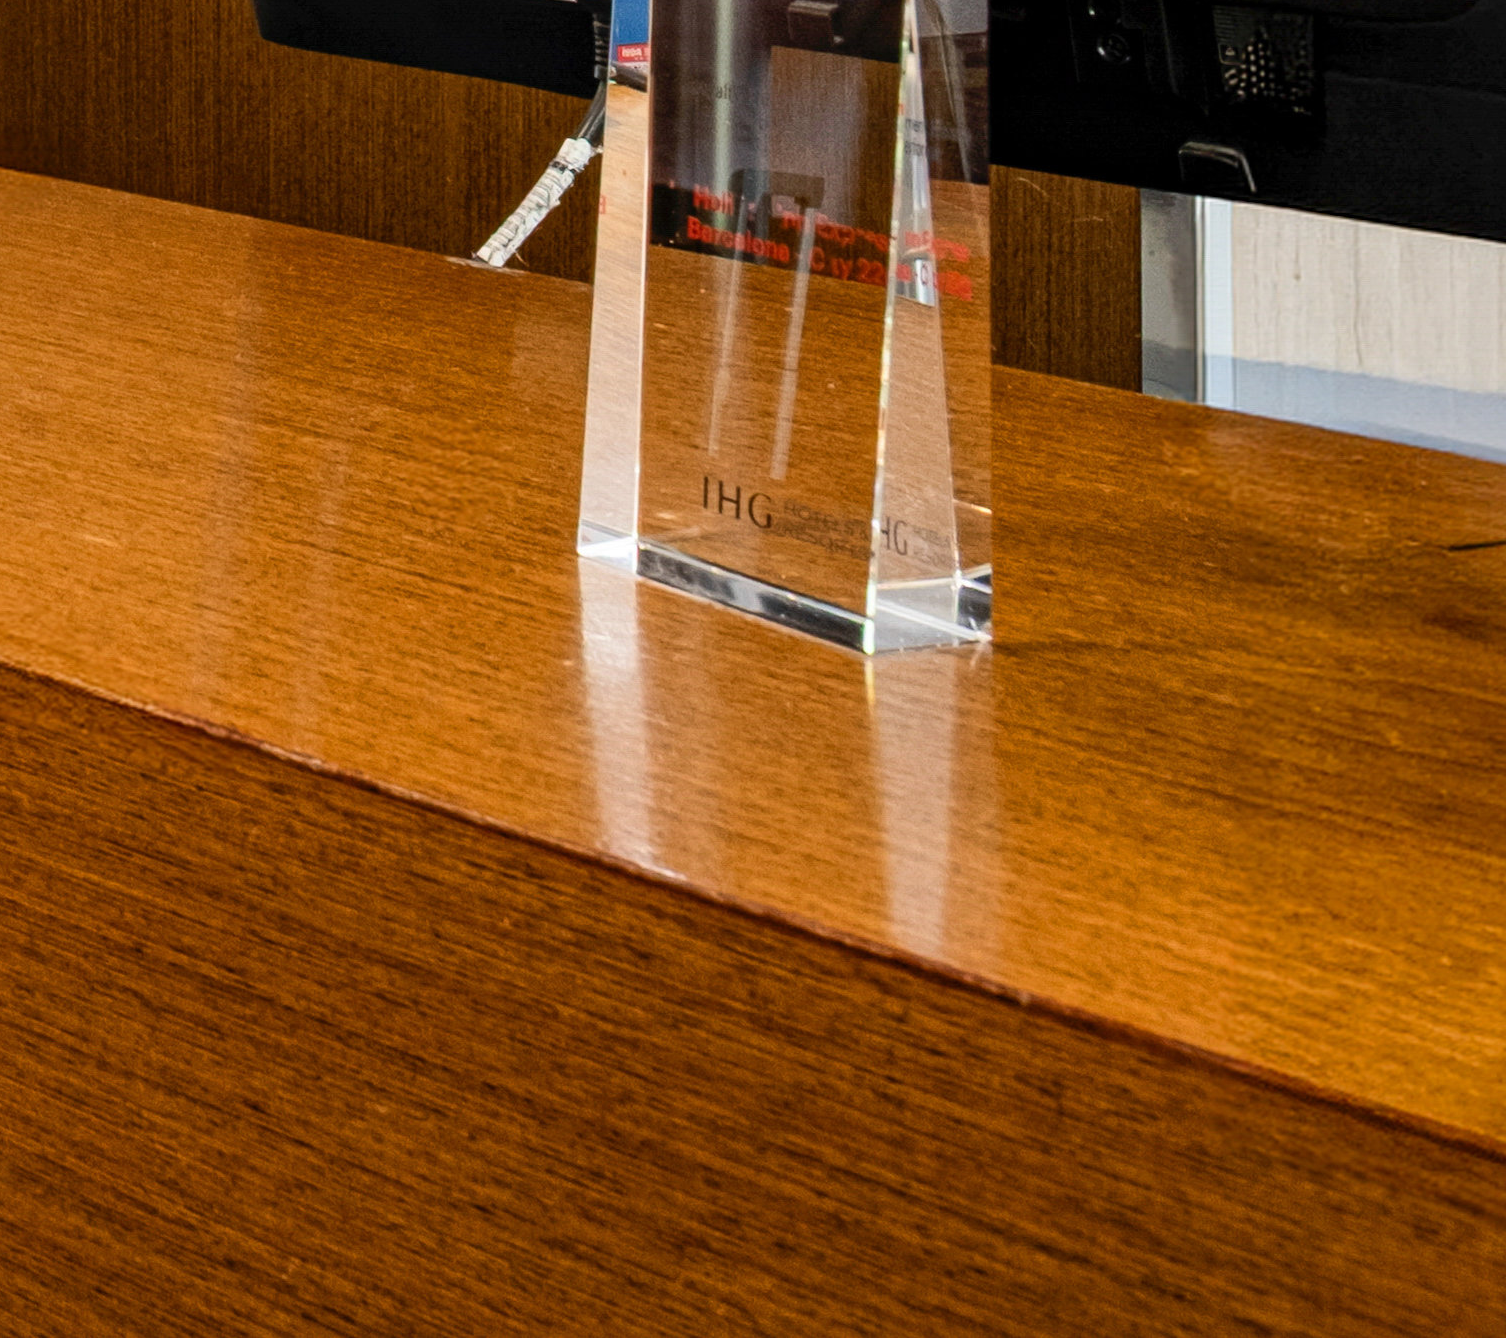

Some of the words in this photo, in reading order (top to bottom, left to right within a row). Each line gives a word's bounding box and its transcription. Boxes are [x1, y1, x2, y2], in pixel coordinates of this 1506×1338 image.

[687, 215, 790, 264] Barcelona
[809, 245, 852, 283] Cty
[702, 476, 772, 529] IHG
